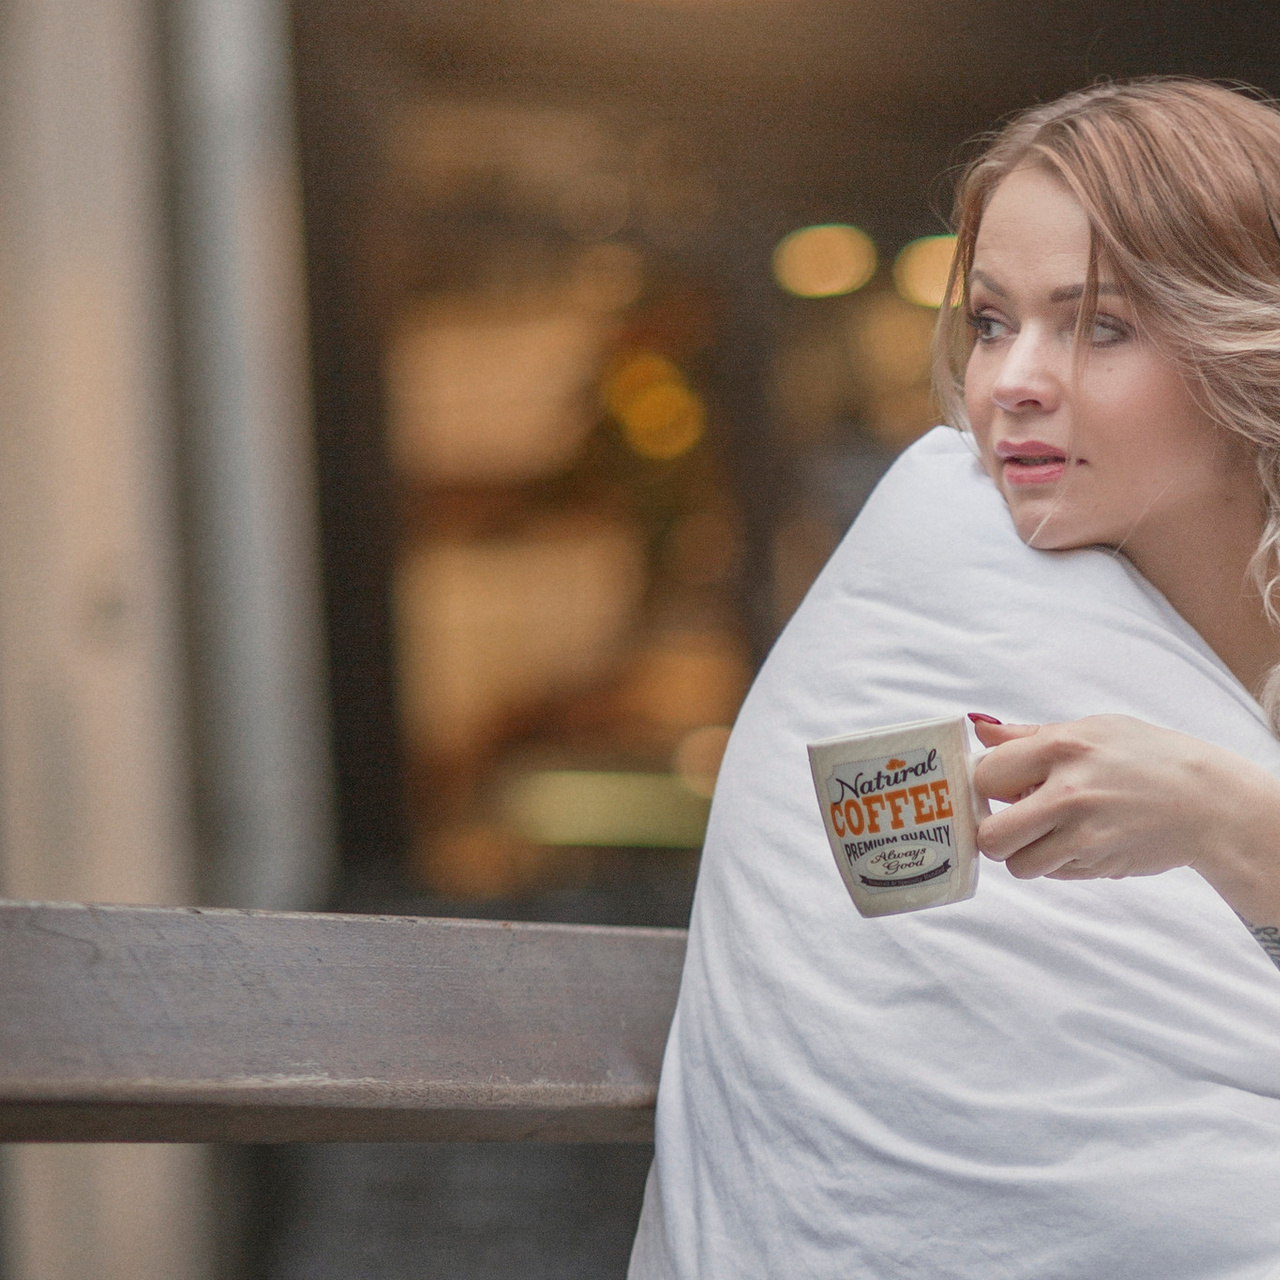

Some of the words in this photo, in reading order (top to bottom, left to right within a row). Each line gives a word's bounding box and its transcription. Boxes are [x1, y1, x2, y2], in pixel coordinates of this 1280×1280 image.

[834, 749, 937, 804] Natural
[830, 779, 954, 838] COFFEE
[844, 836, 897, 866] PREMIUM
[901, 825, 950, 847] QUALITY
[870, 847, 926, 864] Always
[882, 856, 924, 875] Good
